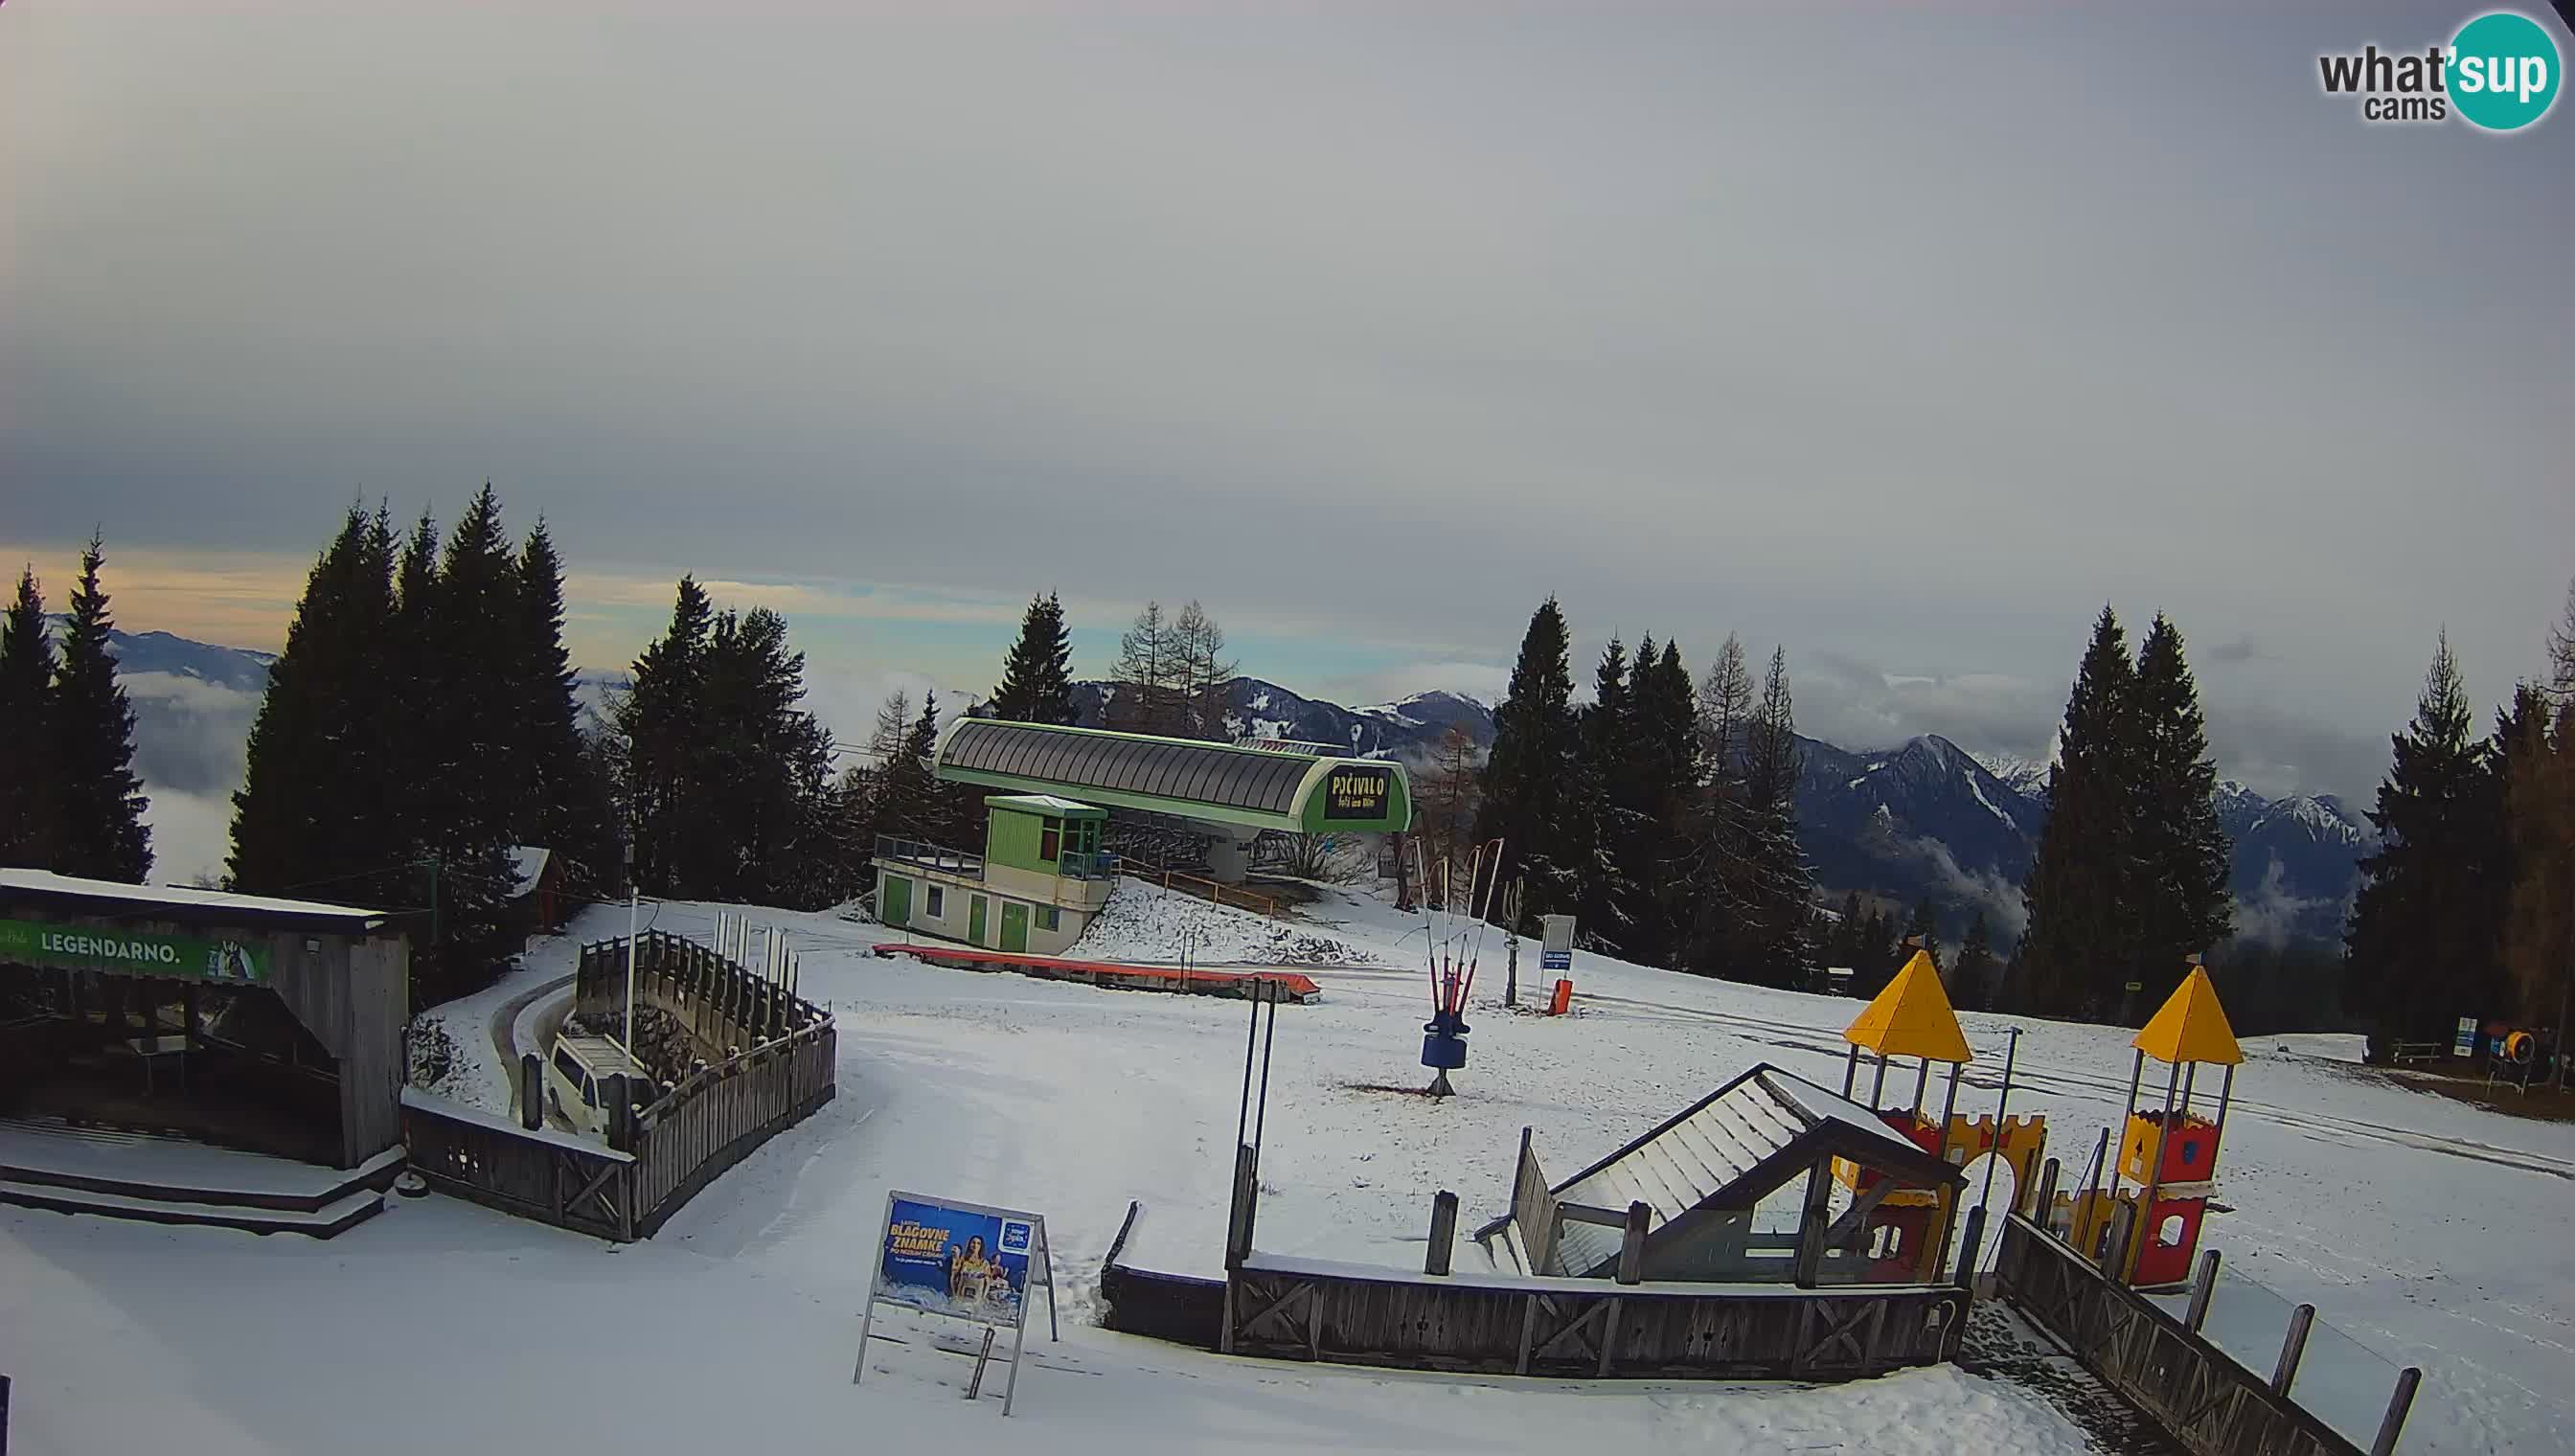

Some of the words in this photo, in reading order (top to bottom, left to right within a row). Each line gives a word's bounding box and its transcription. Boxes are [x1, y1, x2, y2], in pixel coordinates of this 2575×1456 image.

[41, 933, 181, 965] LEGENDARNO.
[890, 1224, 950, 1241] BLAGOVNE
[893, 1237, 944, 1252] ZNAMKE
